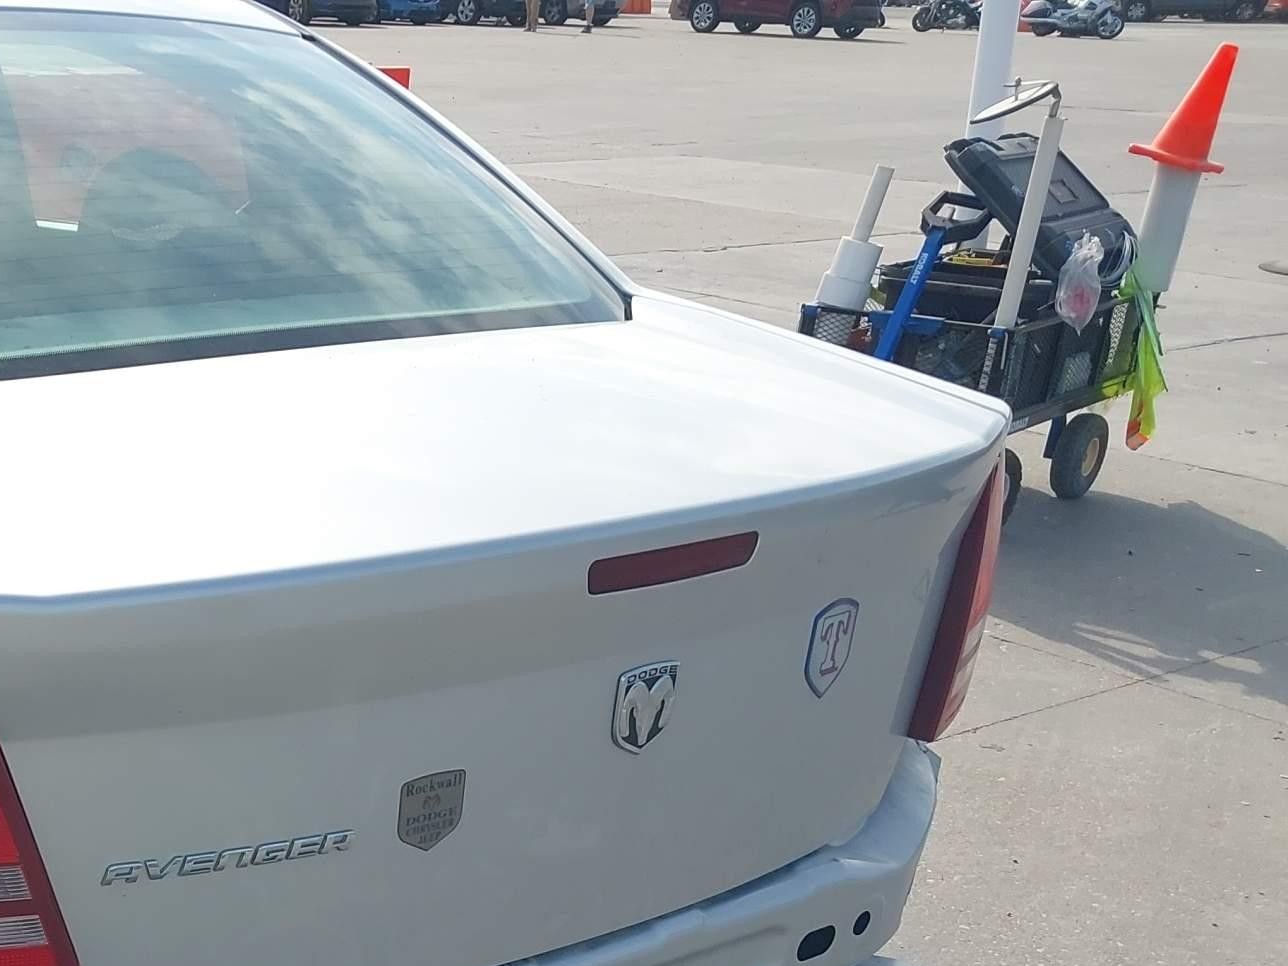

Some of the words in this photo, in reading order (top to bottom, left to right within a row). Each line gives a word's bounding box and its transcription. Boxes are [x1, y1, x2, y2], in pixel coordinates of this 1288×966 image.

[819, 609, 852, 677] T
[626, 664, 679, 685] DODGE
[406, 772, 463, 798] Rockwall
[406, 806, 457, 827] DODGE
[100, 829, 355, 887] AVENGER
